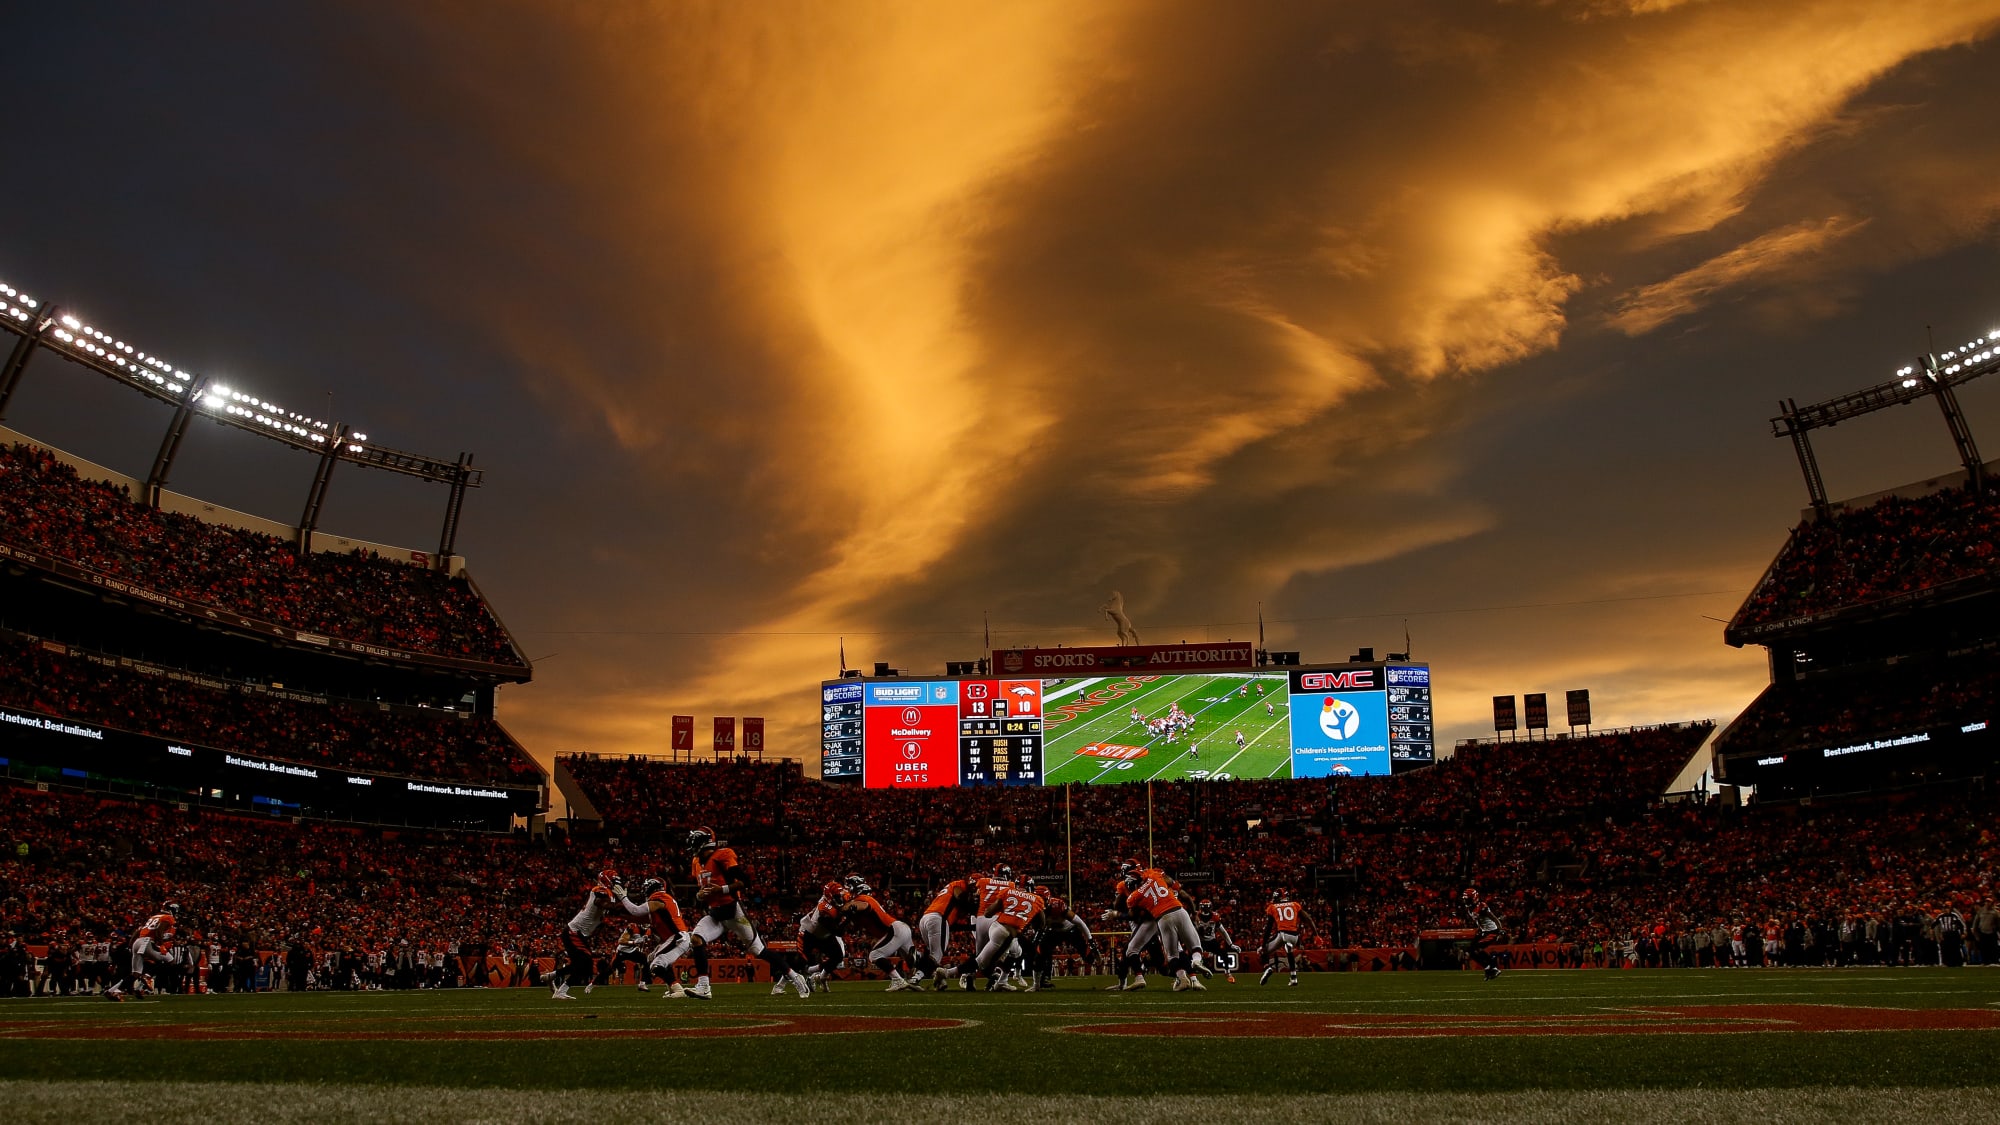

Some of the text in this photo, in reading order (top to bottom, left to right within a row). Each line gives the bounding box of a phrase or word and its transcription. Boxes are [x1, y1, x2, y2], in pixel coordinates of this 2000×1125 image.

[93, 575, 102, 584] 53
[106, 579, 128, 592] RANDY
[130, 586, 167, 604] GRADISHAR
[1765, 622, 1784, 632] JOHN
[1788, 616, 1813, 627] LYNCH
[351, 644, 389, 656] RED MILLER
[1034, 654, 1095, 667] SPORTS
[1150, 649, 1249, 663] AUTHORITY
[1301, 671, 1373, 689] GMC
[834, 691, 862, 700] SCORES
[972, 702, 984, 713] 13
[1019, 701, 1030, 712] 10
[6, 714, 103, 740] network. Best unlimited.
[1007, 723, 1023, 731] 0:24
[1961, 722, 1986, 733] verizon
[678, 730, 687, 744] 7
[715, 731, 733, 745] 44
[745, 732, 760, 746] 18
[1824, 733, 1930, 757] Best network. Best unlimited.
[168, 746, 318, 778] verizon Best network. Best unlimited.
[896, 763, 928, 771] UBER
[1758, 756, 1784, 766] verizon
[896, 774, 928, 783] EATS
[348, 776, 508, 799] verizon Best network. Best unlimited.
[1008, 889, 1036, 902] ANDERSON
[1144, 881, 1169, 906] 76
[1004, 896, 1032, 921] 22
[1277, 907, 1294, 921] 10
